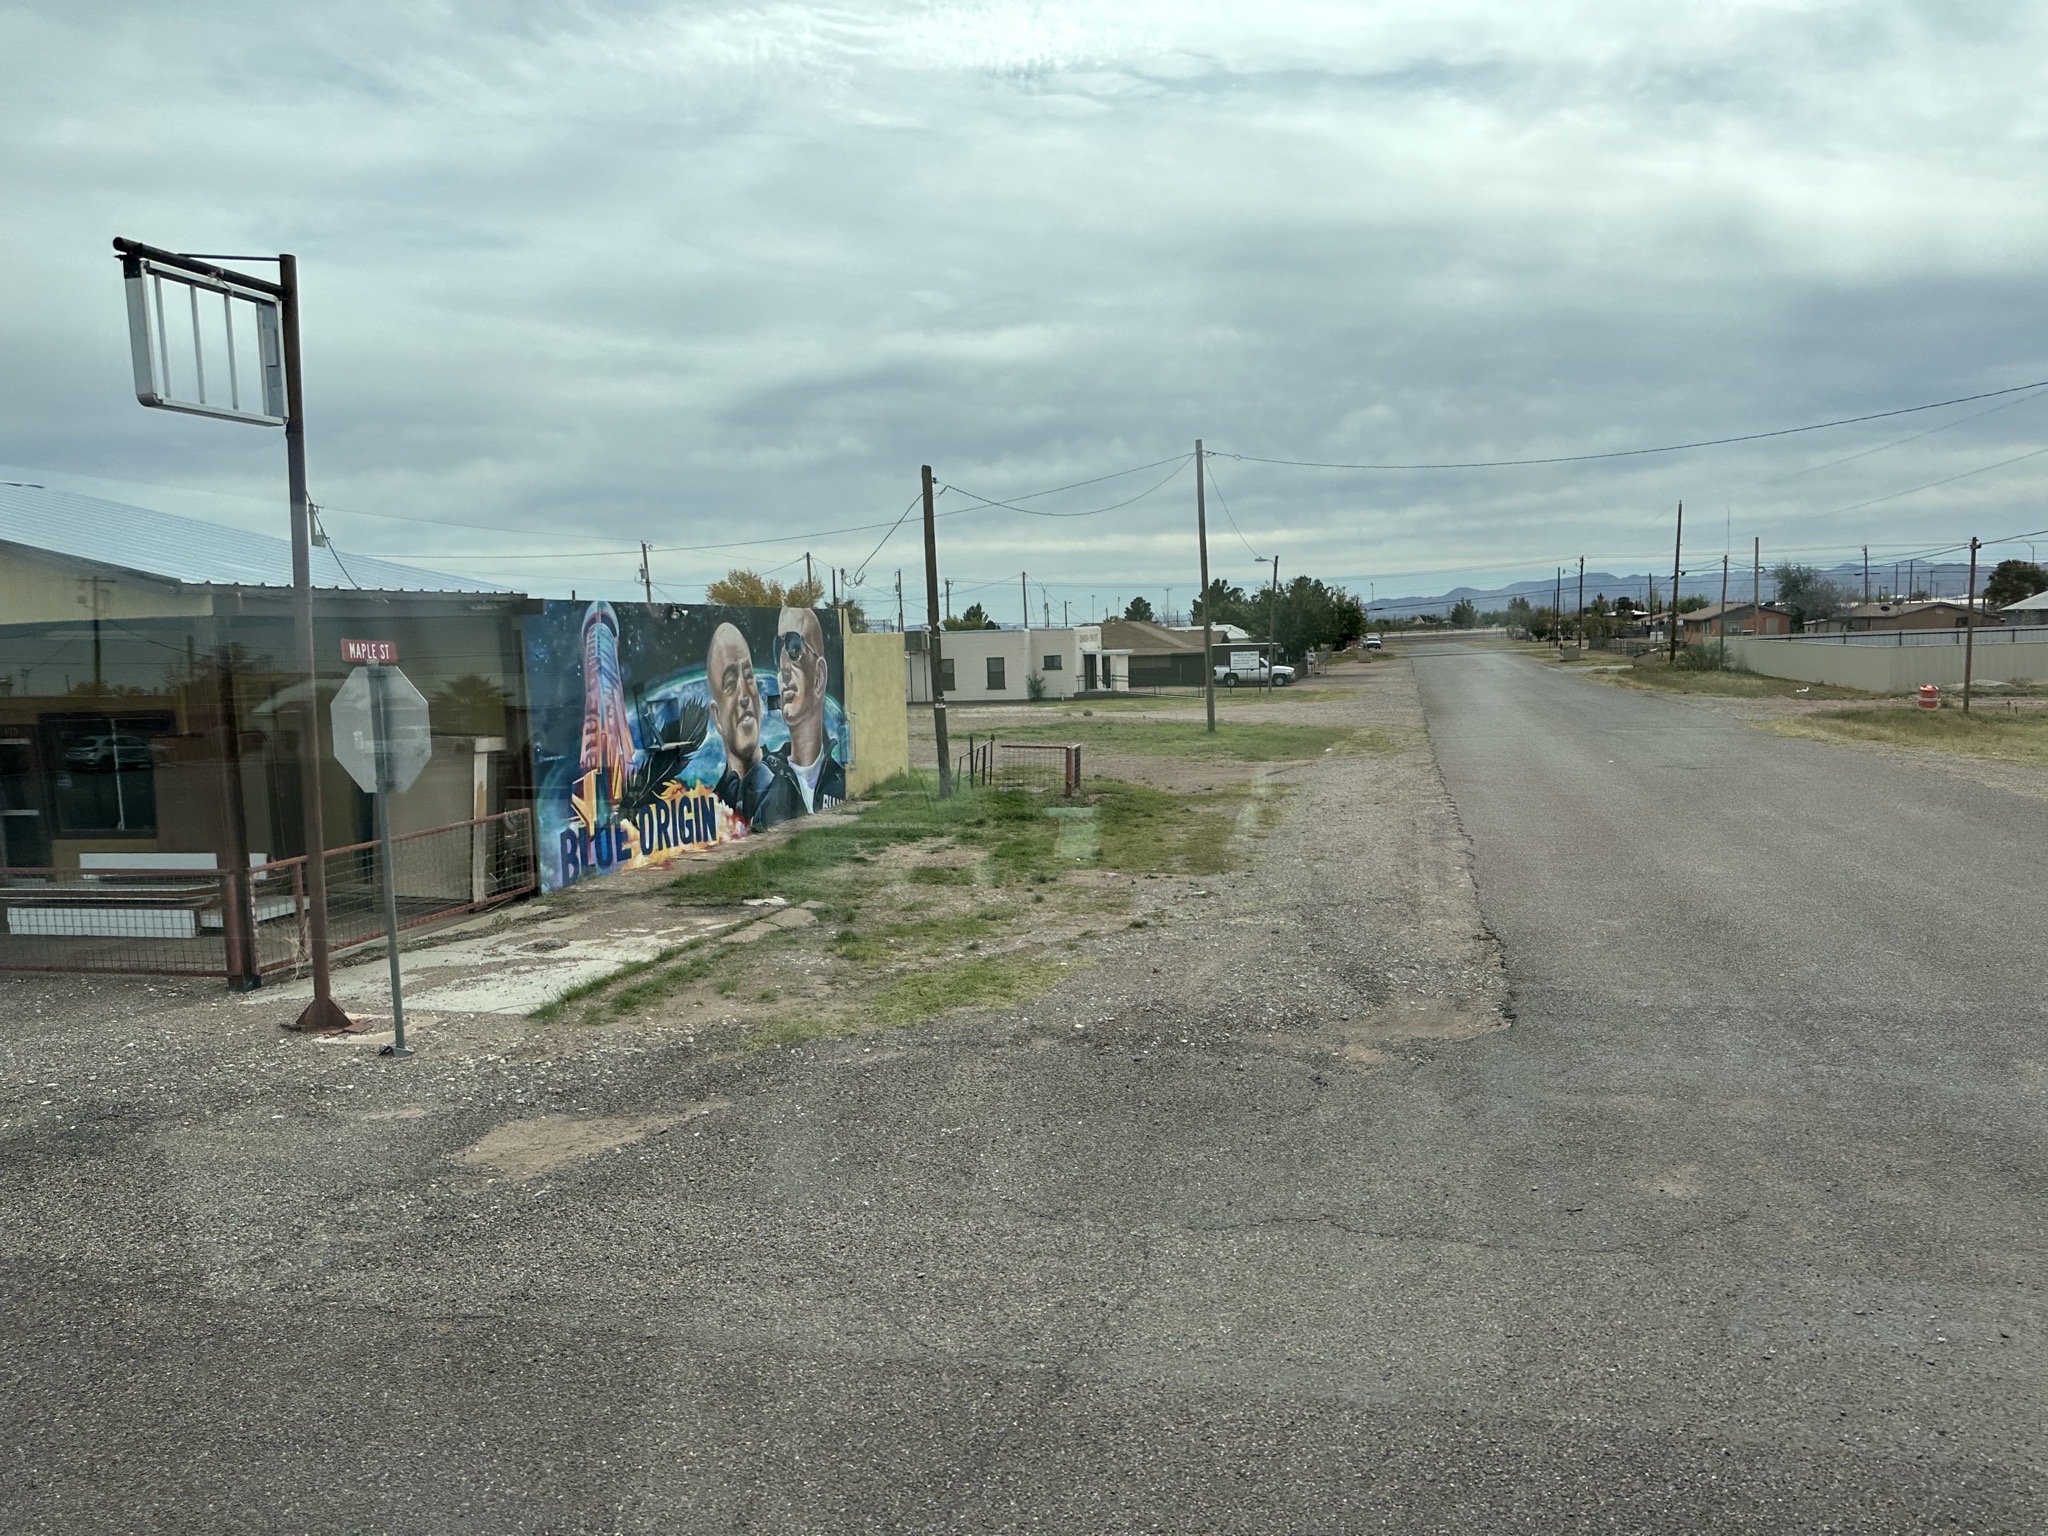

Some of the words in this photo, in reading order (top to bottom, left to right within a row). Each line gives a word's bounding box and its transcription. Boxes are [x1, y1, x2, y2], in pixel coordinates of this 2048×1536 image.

[349, 642, 377, 659] MAPLE
[379, 644, 390, 660] ST
[560, 824, 632, 888] BLUE
[639, 796, 717, 855] ORIGIN
